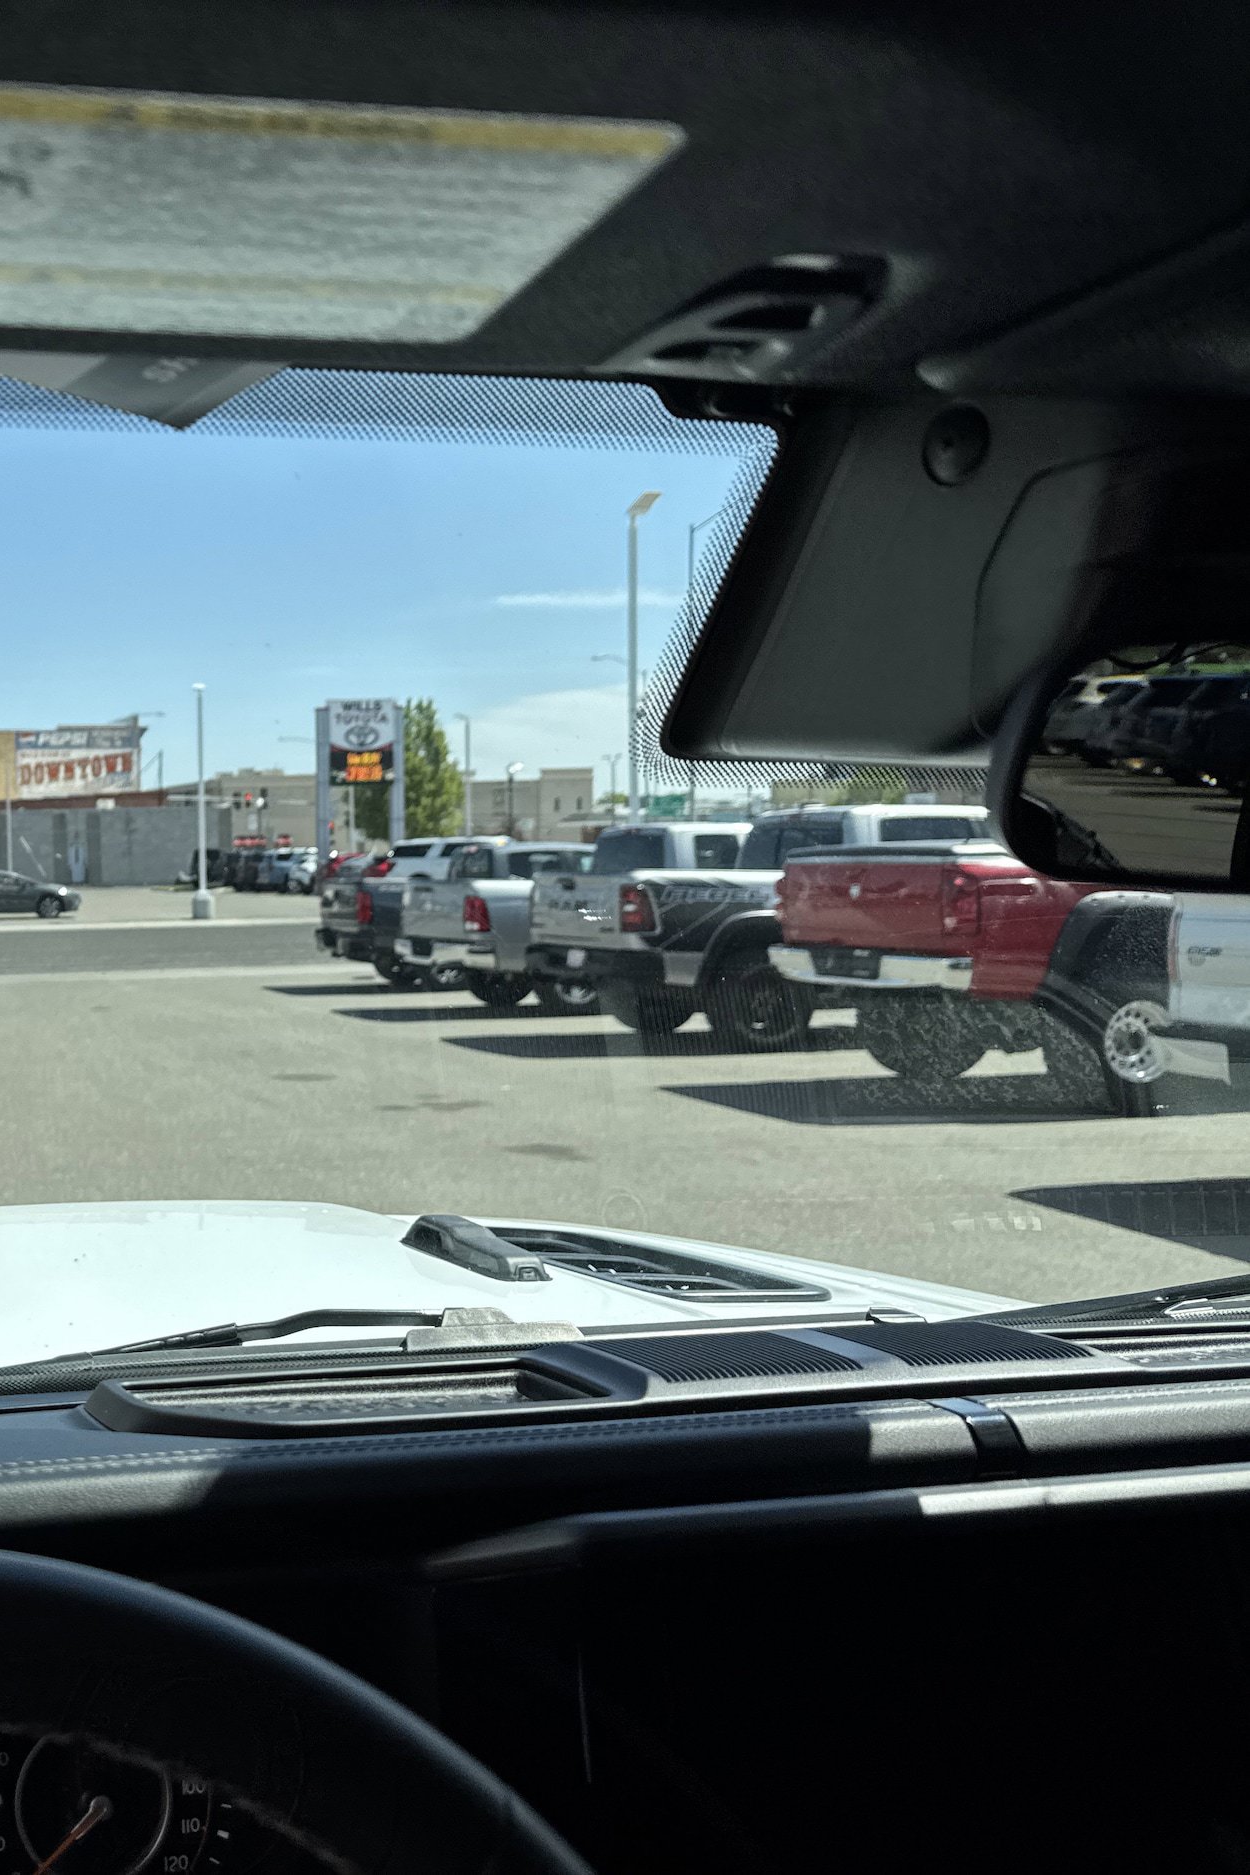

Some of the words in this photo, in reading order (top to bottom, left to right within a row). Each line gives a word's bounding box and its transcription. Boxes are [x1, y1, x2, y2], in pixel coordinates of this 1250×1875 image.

[19, 752, 133, 785] DOWNTOWN
[181, 1819, 200, 1833] 110
[163, 1855, 190, 1873] 120
